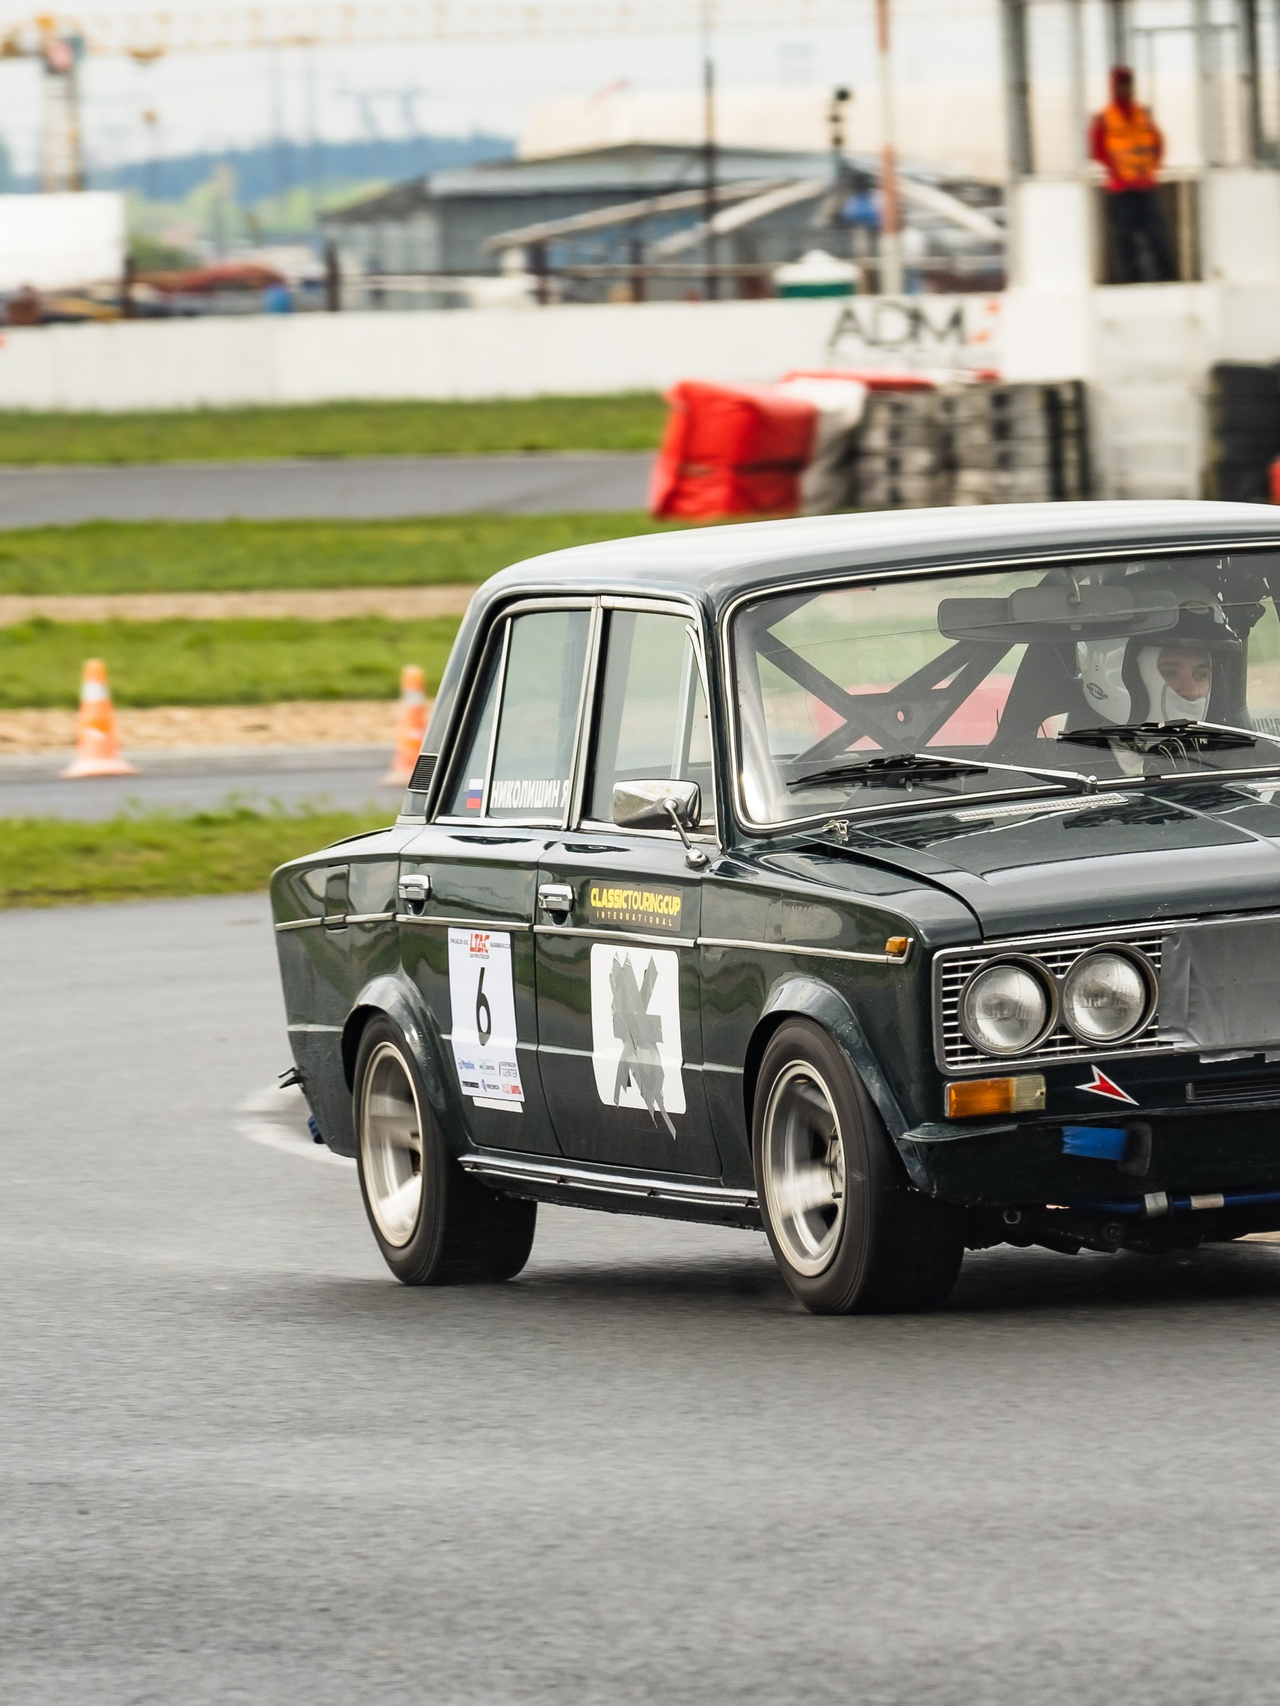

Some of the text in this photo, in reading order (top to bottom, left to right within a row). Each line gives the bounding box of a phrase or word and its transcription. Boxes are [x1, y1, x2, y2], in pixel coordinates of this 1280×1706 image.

[827, 303, 968, 351] ADM
[490, 780, 561, 809] НИКОЛИШИН
[590, 887, 681, 916] CLASSICTOURINGCUP
[596, 911, 673, 927] INTERNATIONAL
[476, 967, 491, 1046] 6
